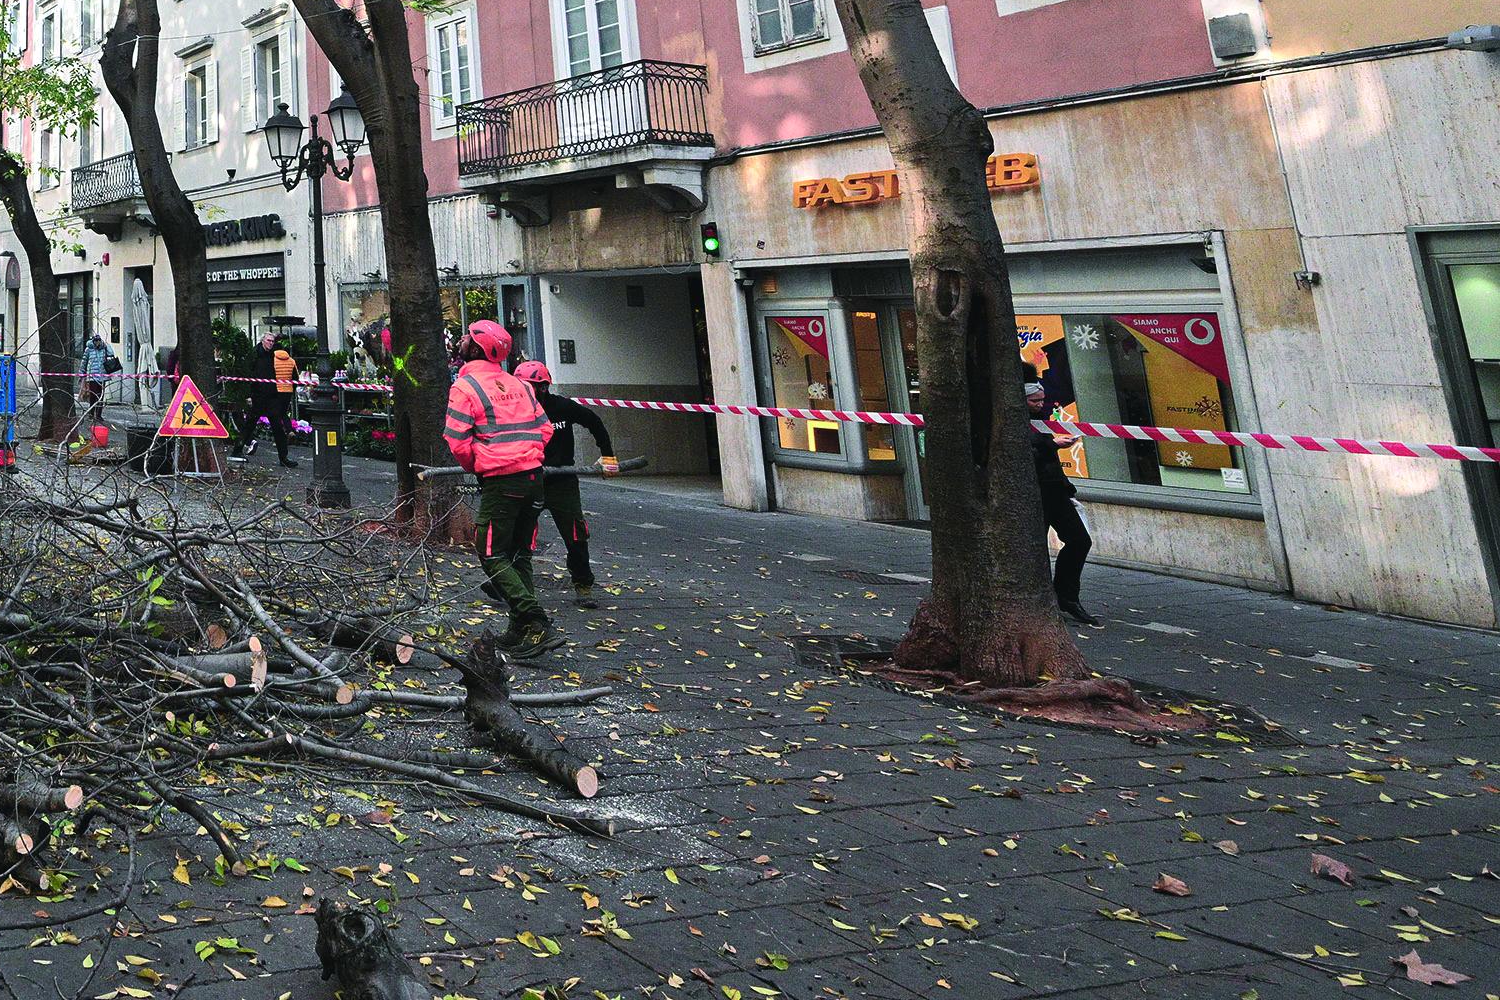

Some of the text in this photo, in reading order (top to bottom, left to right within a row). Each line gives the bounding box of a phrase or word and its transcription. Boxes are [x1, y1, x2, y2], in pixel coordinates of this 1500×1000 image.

[792, 152, 1041, 208] FASTB
[212, 271, 222, 282] OF
[223, 270, 239, 281] THE
[240, 267, 278, 280] WHOPPER
[1132, 318, 1159, 326] SIAMO
[1149, 327, 1178, 335] ANCHE
[1164, 336, 1180, 344] QUI
[552, 421, 566, 430] ENT
